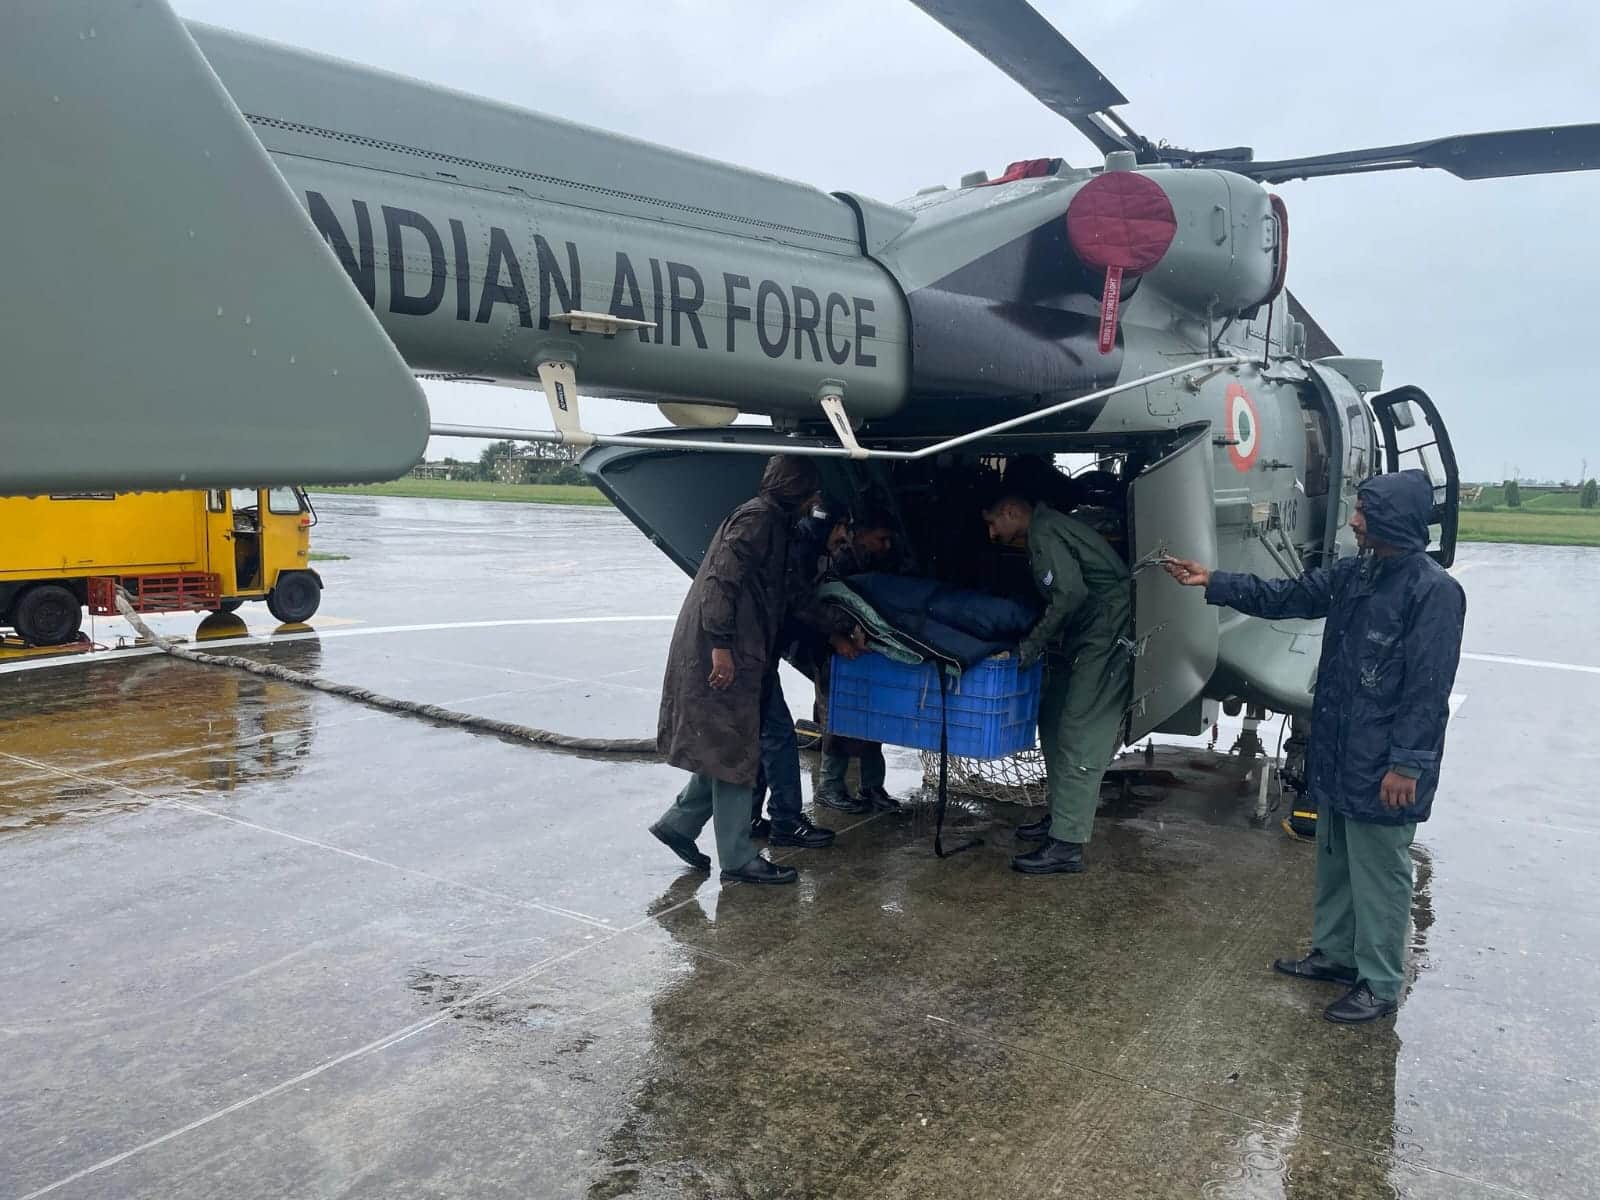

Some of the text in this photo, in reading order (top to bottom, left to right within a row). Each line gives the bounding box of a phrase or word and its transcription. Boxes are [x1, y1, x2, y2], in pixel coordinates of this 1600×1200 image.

[608, 251, 708, 350] AIR
[722, 272, 877, 368] FORCE
[1108, 277, 1118, 299] FLIGHT
